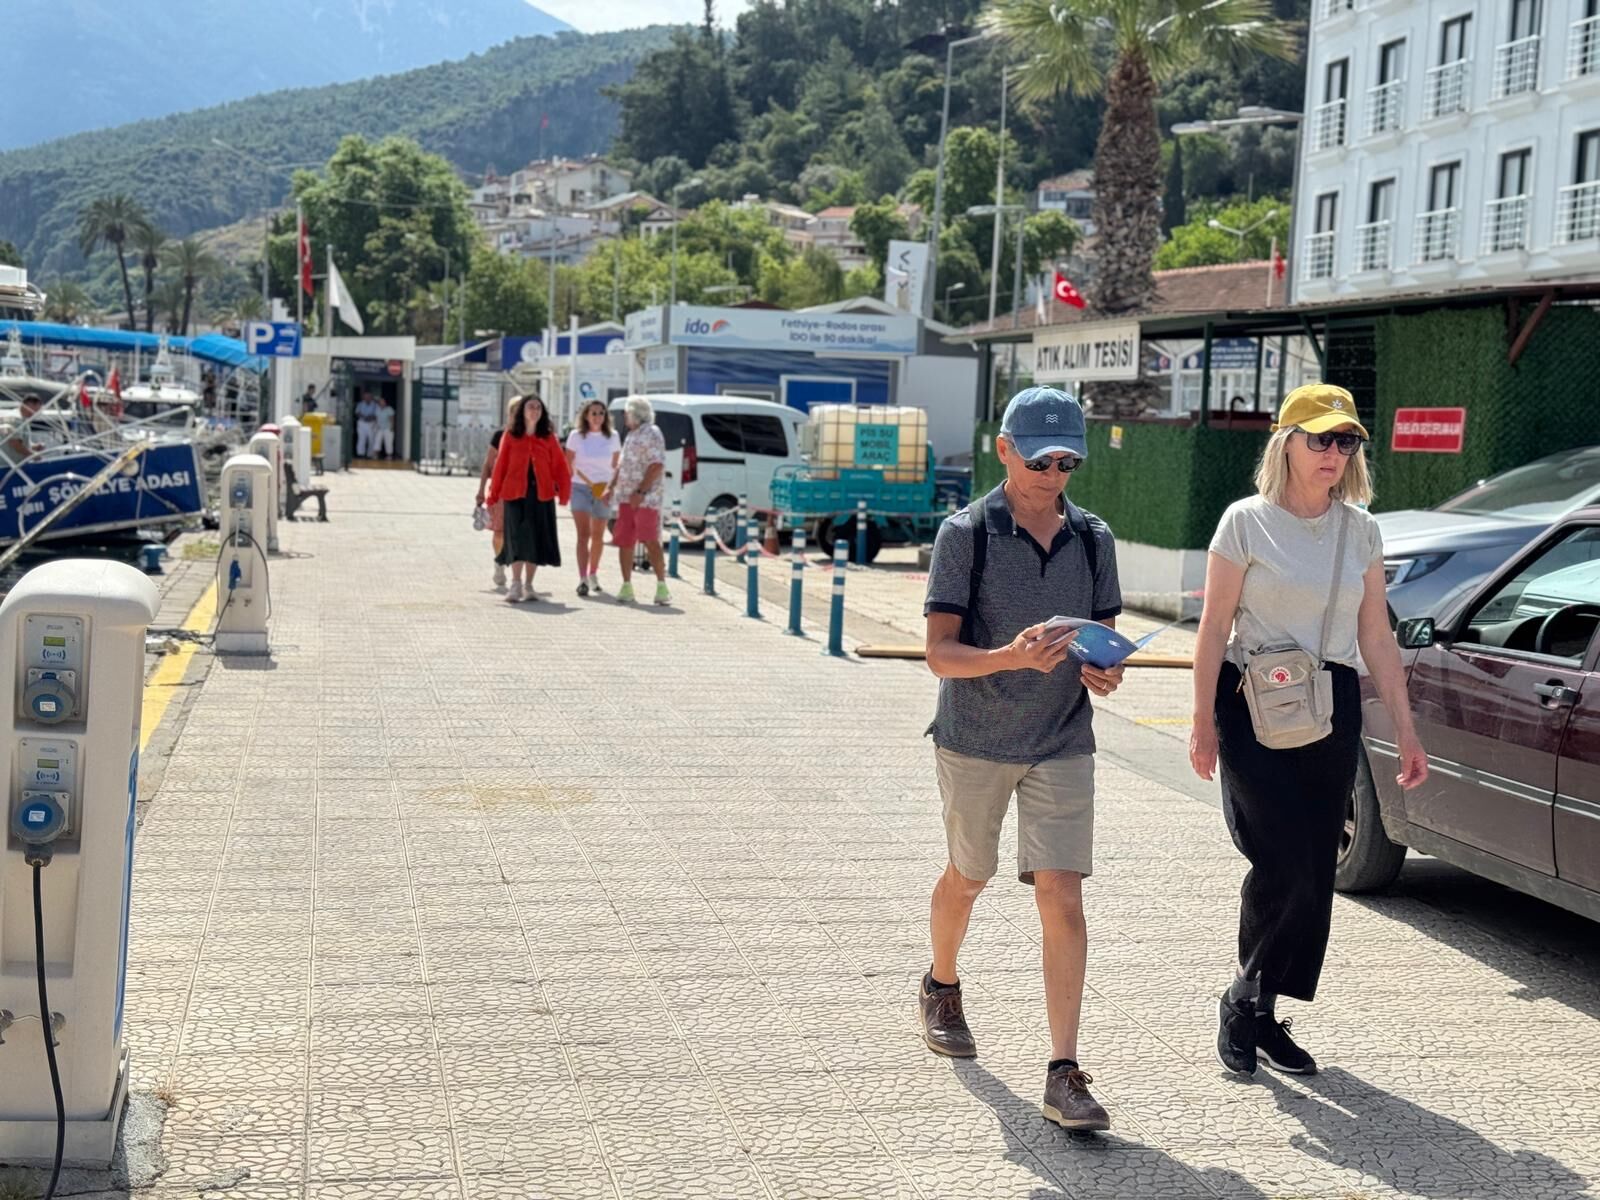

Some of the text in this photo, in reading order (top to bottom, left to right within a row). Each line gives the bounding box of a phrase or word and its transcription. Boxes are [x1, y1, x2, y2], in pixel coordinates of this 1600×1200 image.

[249, 322, 275, 354] P
[684, 318, 710, 334] ido
[1036, 333, 1133, 371] ATIK ALIM TESİSİ
[861, 451, 891, 462] ARAÇ
[48, 477, 131, 504] ŞÖVLYE
[136, 471, 190, 491] ADASI
